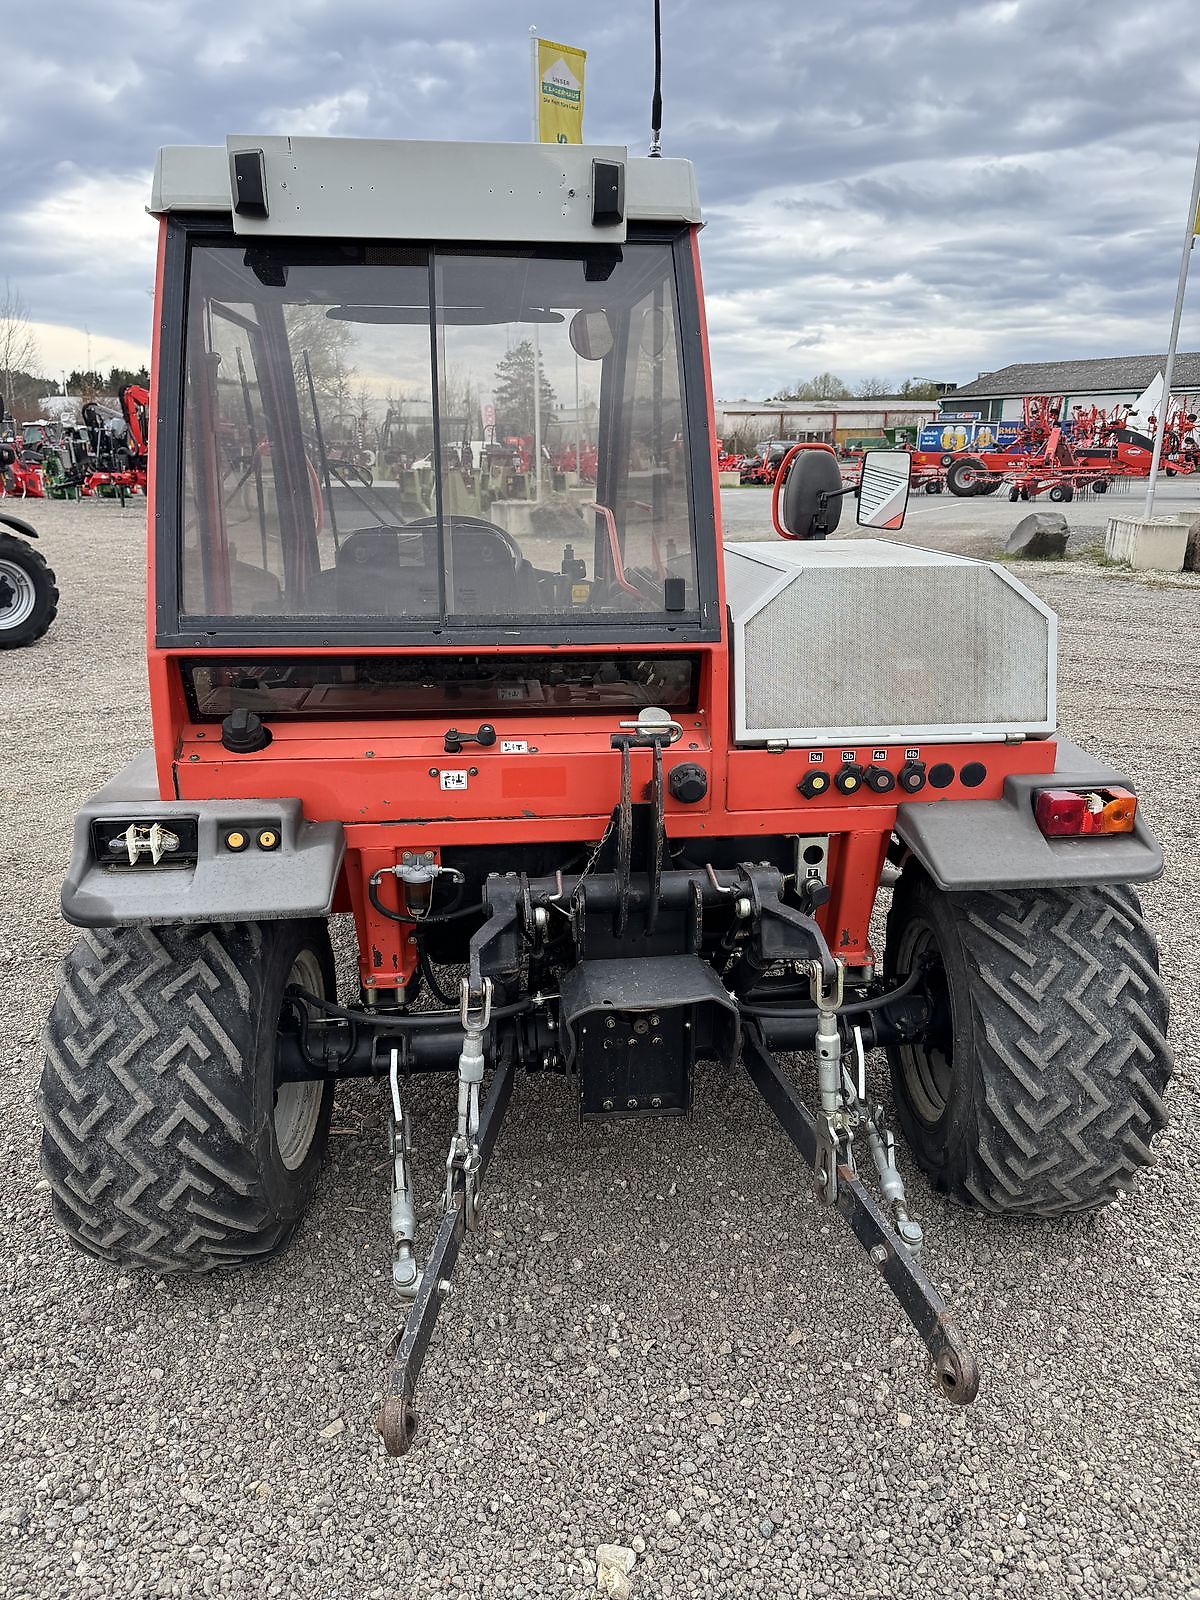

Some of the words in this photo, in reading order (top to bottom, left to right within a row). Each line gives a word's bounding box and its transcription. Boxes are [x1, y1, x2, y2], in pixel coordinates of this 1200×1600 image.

[811, 753, 821, 761] 3a
[844, 752, 854, 760] 3b
[874, 751, 885, 759] 4a
[907, 750, 917, 758] 4b
